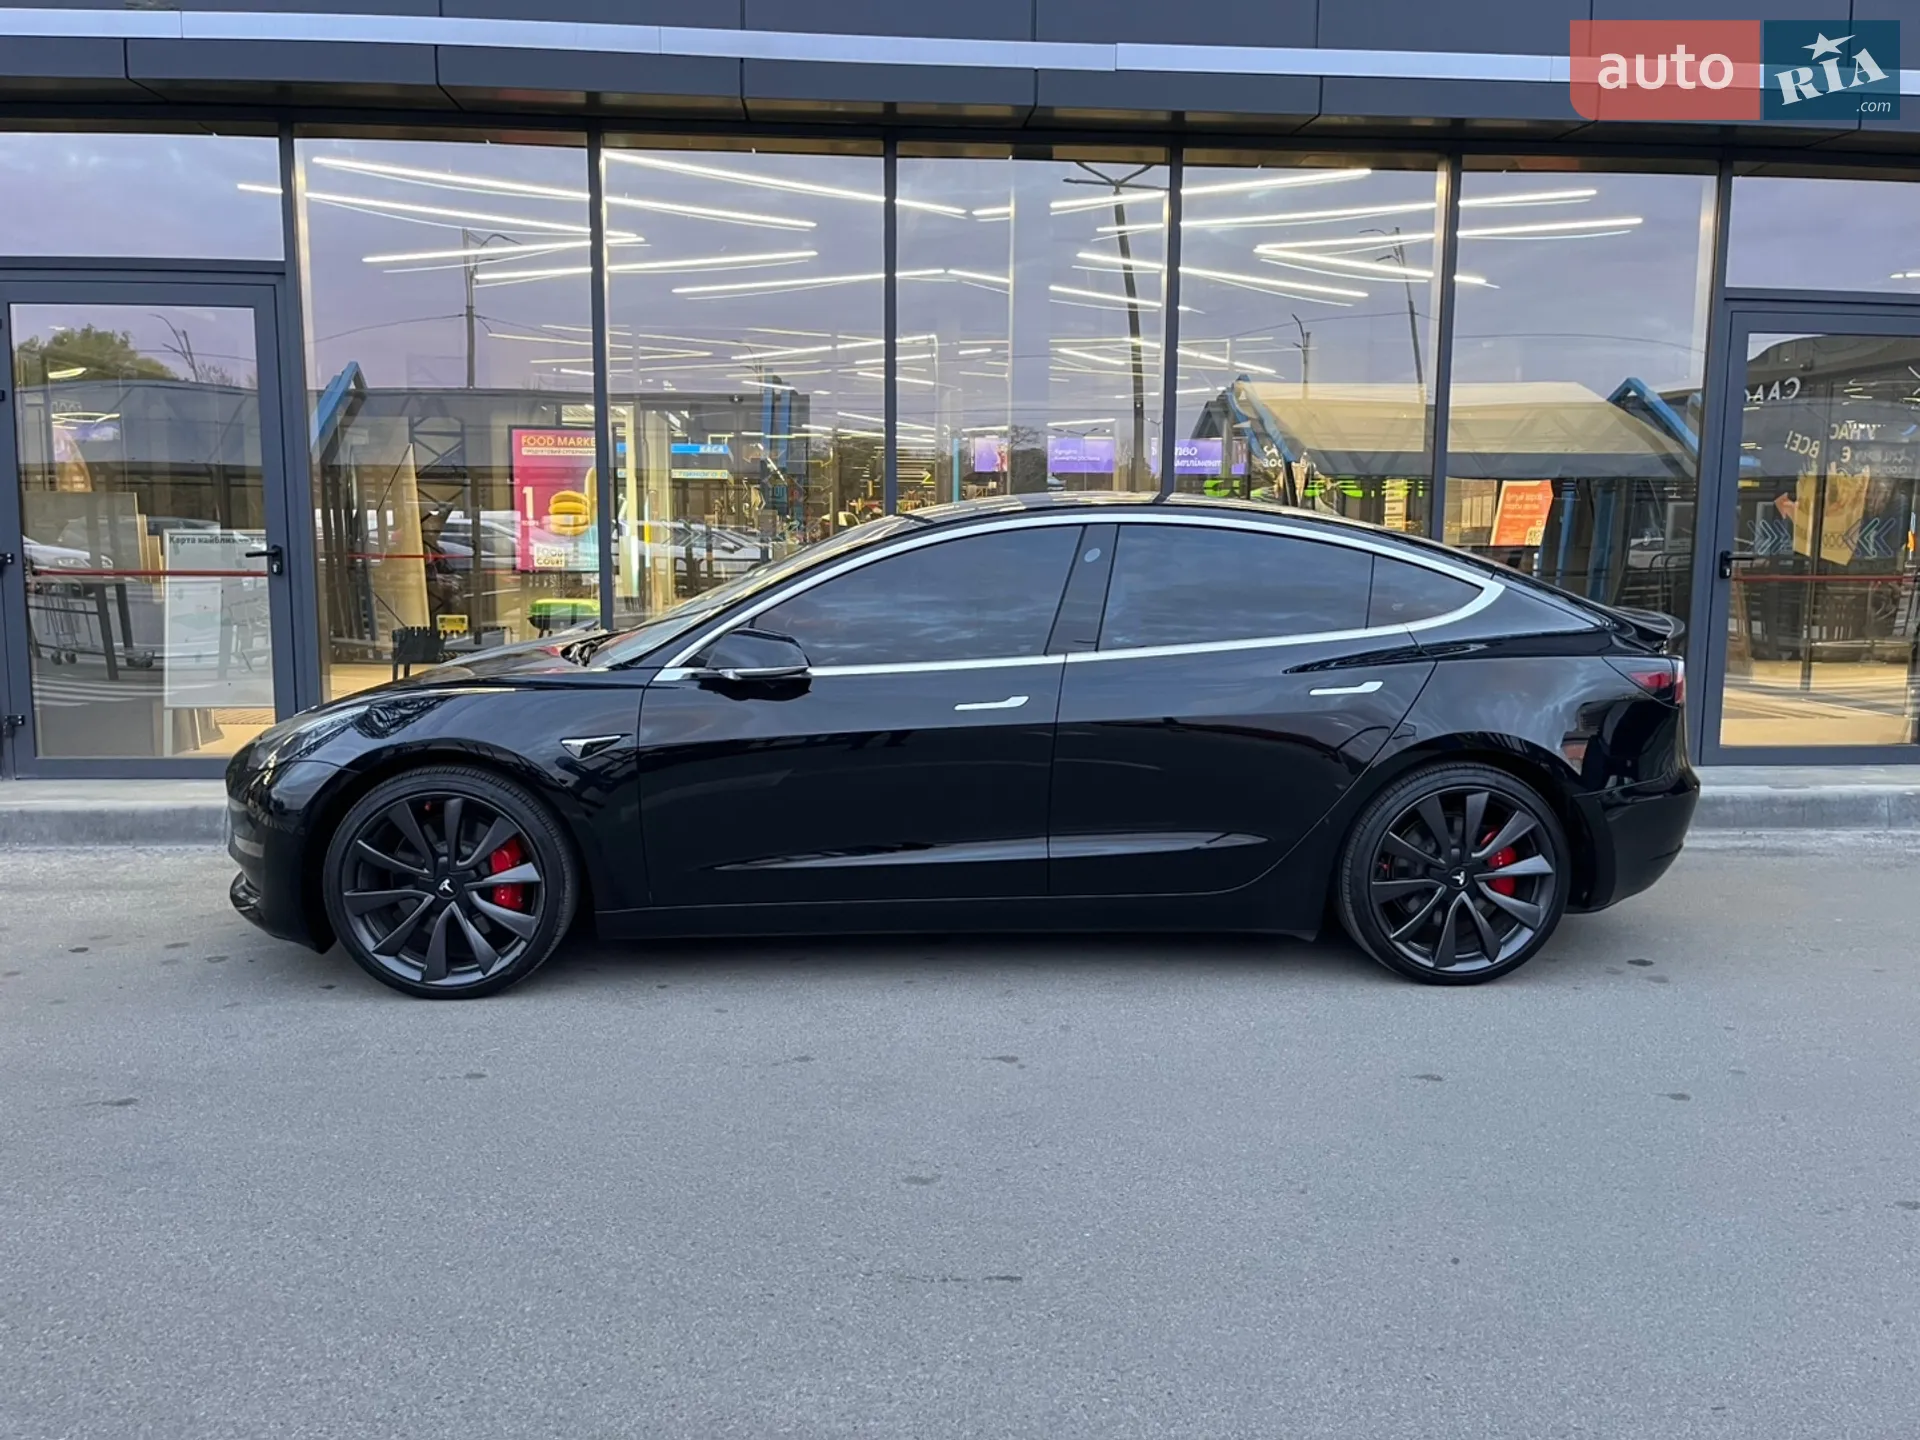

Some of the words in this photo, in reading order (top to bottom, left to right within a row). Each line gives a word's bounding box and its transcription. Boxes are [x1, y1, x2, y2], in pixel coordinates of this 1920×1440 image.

[522, 435, 555, 447] FOOD
[557, 435, 596, 447] MARKE
[169, 535, 196, 545] Карта
